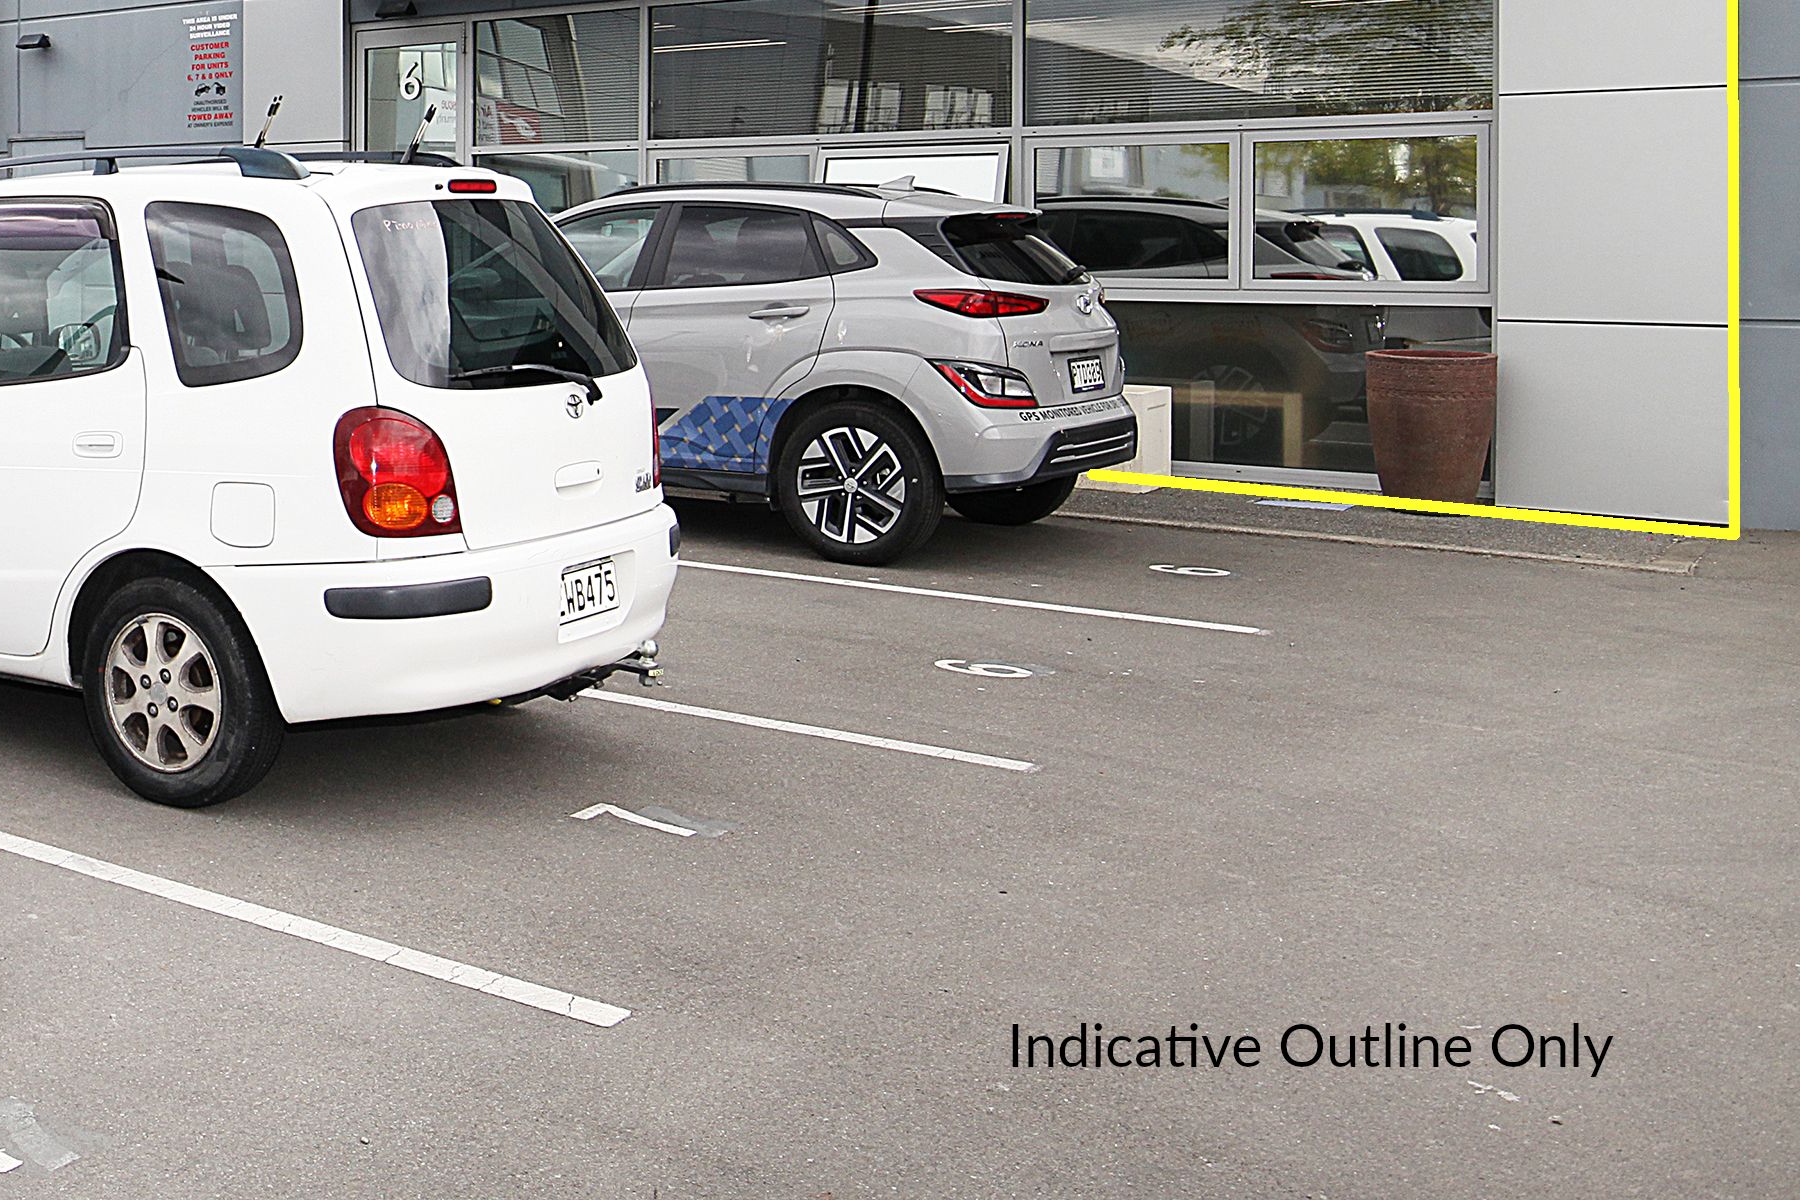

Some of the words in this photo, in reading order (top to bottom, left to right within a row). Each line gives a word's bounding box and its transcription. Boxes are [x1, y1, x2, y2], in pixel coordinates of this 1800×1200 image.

[190, 41, 230, 51] CUSTOMER
[194, 52, 226, 61] PARKING
[192, 63, 206, 71] FOR
[207, 61, 229, 70] UNITS
[214, 71, 234, 79] ONLY
[400, 62, 423, 101] 6
[187, 113, 212, 121] TOWED
[214, 112, 234, 120] AWAY
[1019, 411, 1041, 421] GPS
[1040, 406, 1082, 420] MONITORED
[560, 568, 616, 617] WB475
